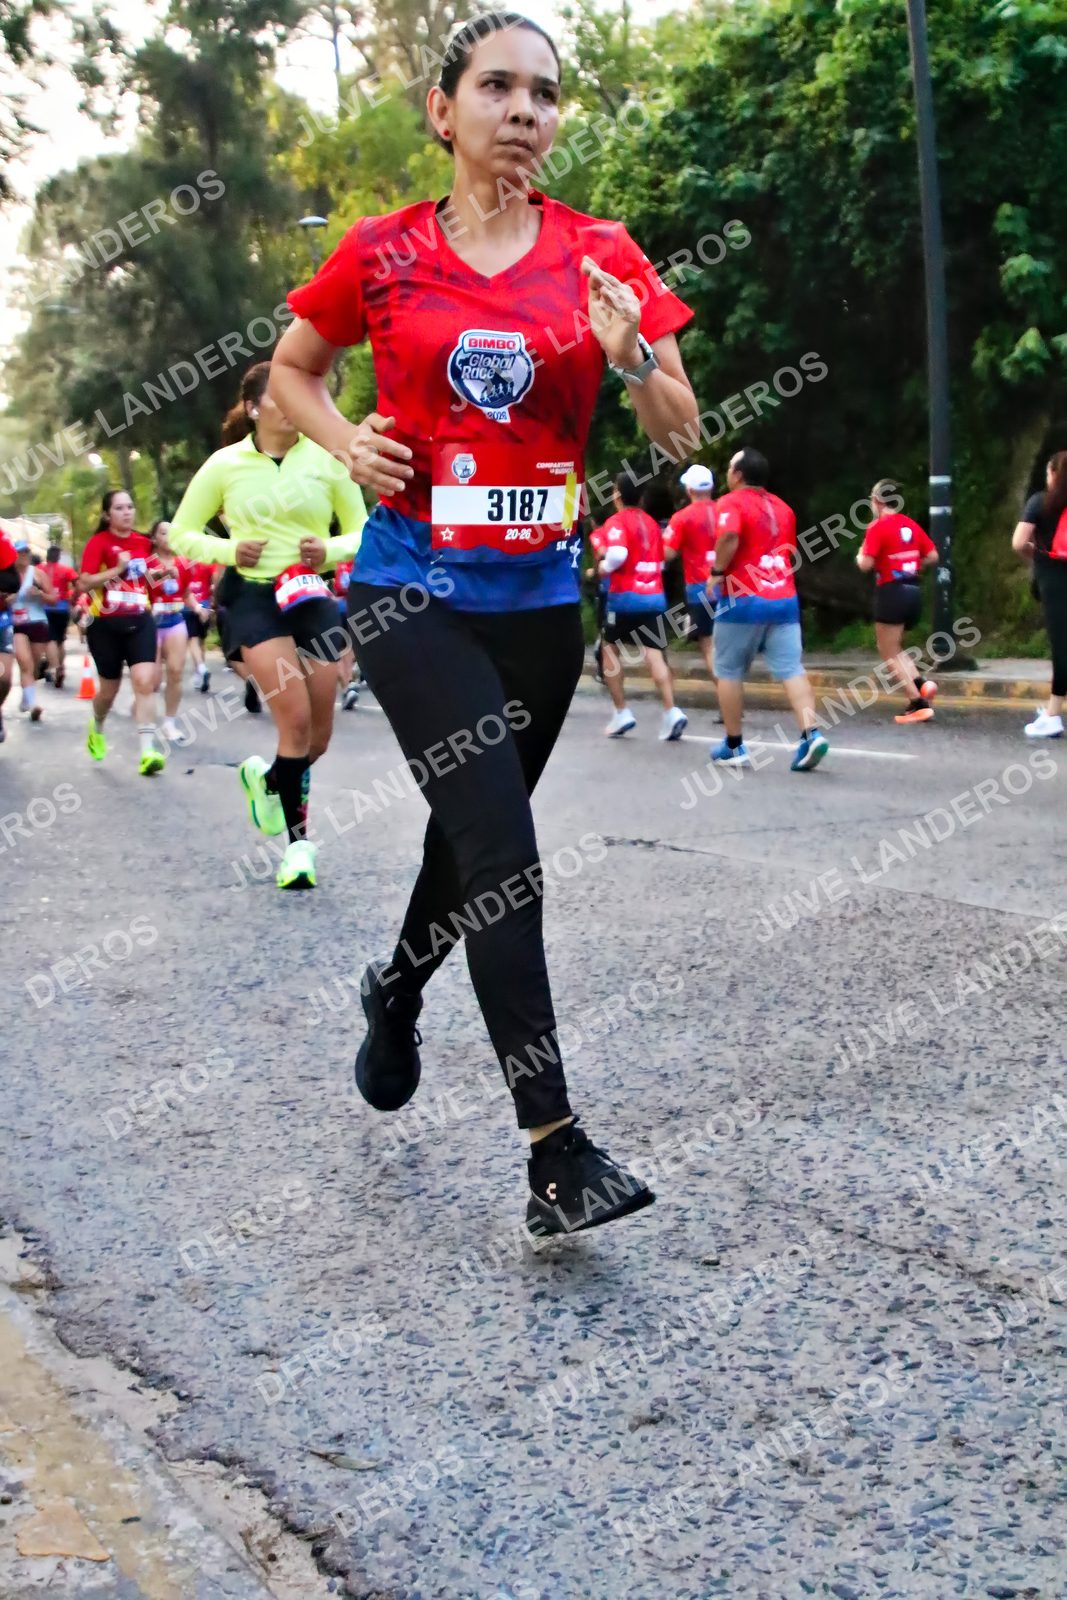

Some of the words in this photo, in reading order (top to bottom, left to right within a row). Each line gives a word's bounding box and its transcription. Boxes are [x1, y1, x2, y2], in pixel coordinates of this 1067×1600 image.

[468, 338, 516, 350] BIMBO
[469, 354, 516, 370] Global
[461, 365, 496, 380] Race
[487, 489, 549, 522] 3187
[504, 528, 533, 541] 20-26
[556, 540, 568, 551] 5K
